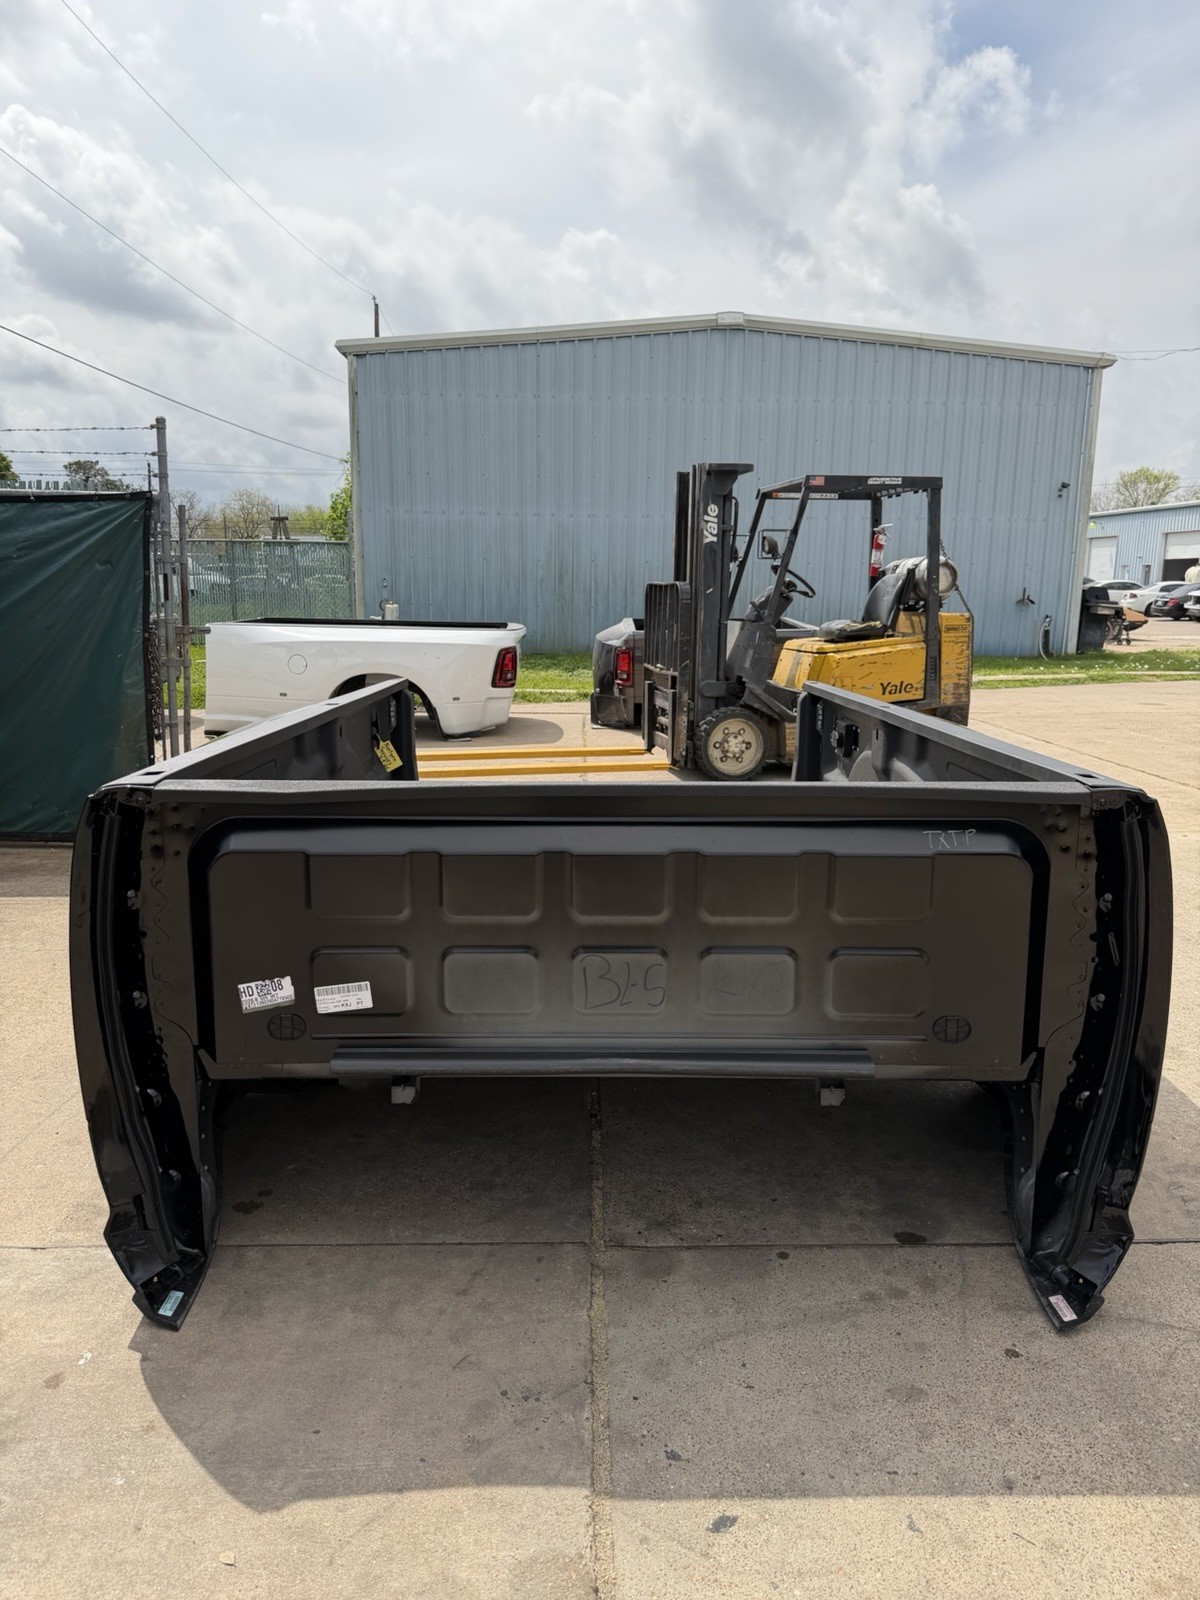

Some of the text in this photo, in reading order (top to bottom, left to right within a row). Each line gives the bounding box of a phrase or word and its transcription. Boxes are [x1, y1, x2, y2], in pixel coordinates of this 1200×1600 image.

[703, 504, 719, 544] Yale
[880, 681, 914, 695] Yale
[239, 979, 284, 998] HD 08
